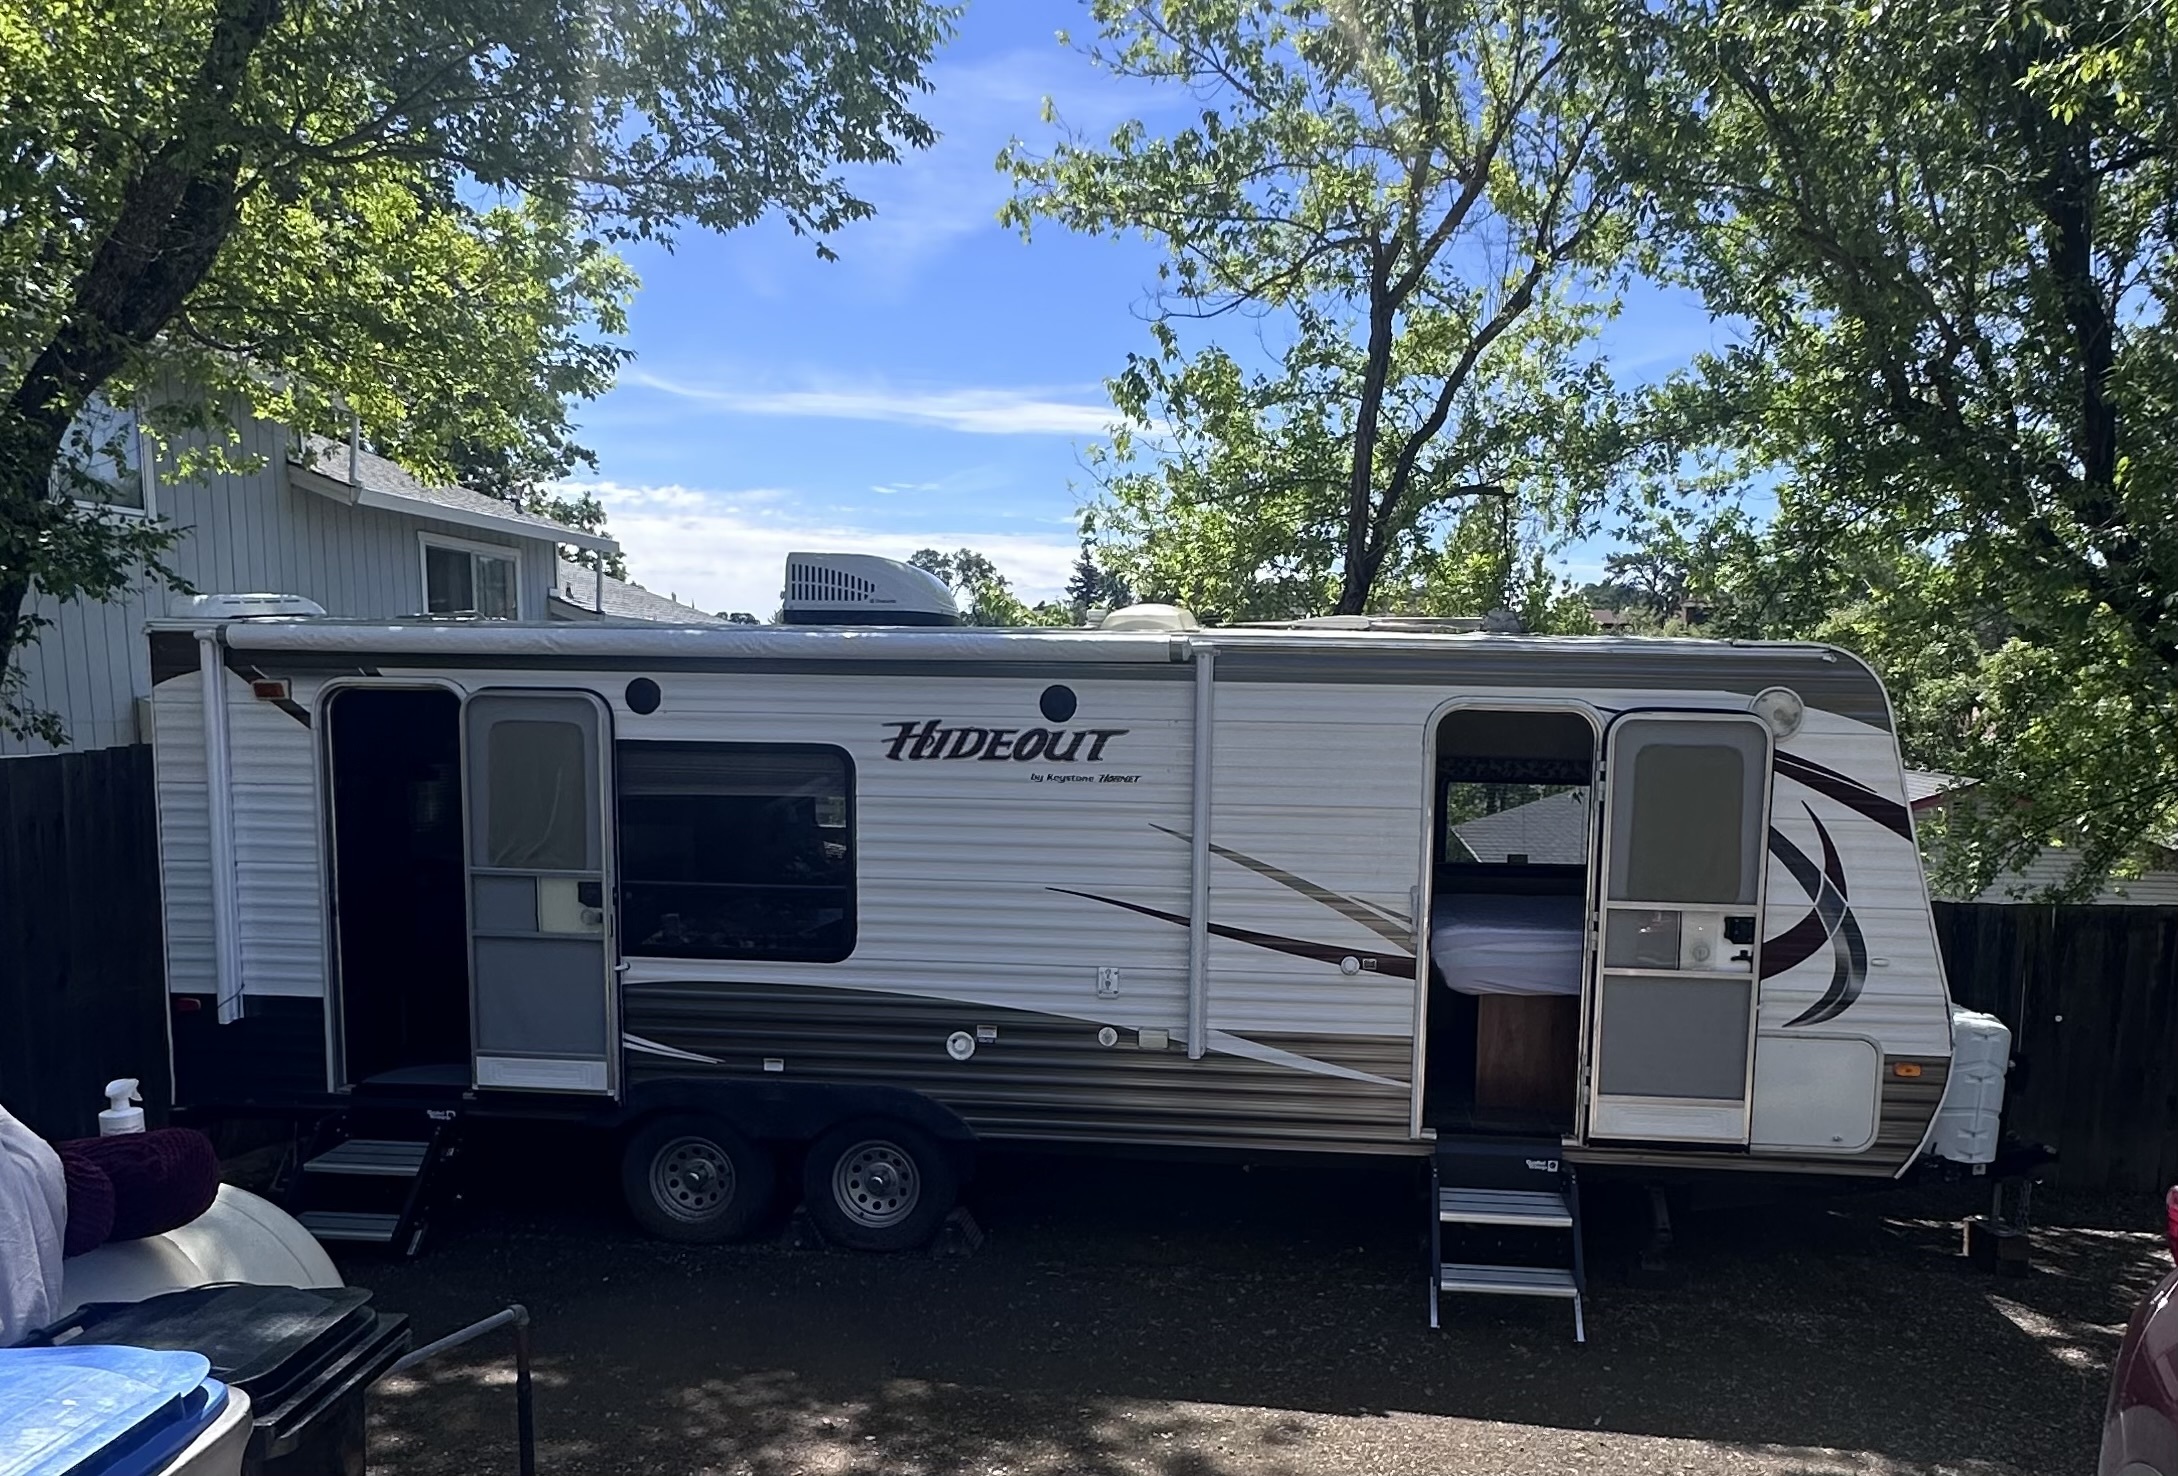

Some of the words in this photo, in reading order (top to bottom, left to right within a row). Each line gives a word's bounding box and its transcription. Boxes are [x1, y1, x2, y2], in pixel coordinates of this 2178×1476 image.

[881, 719, 1130, 762] HIDEOUT
[1030, 773, 1044, 783] by
[1046, 773, 1095, 784] Keystone
